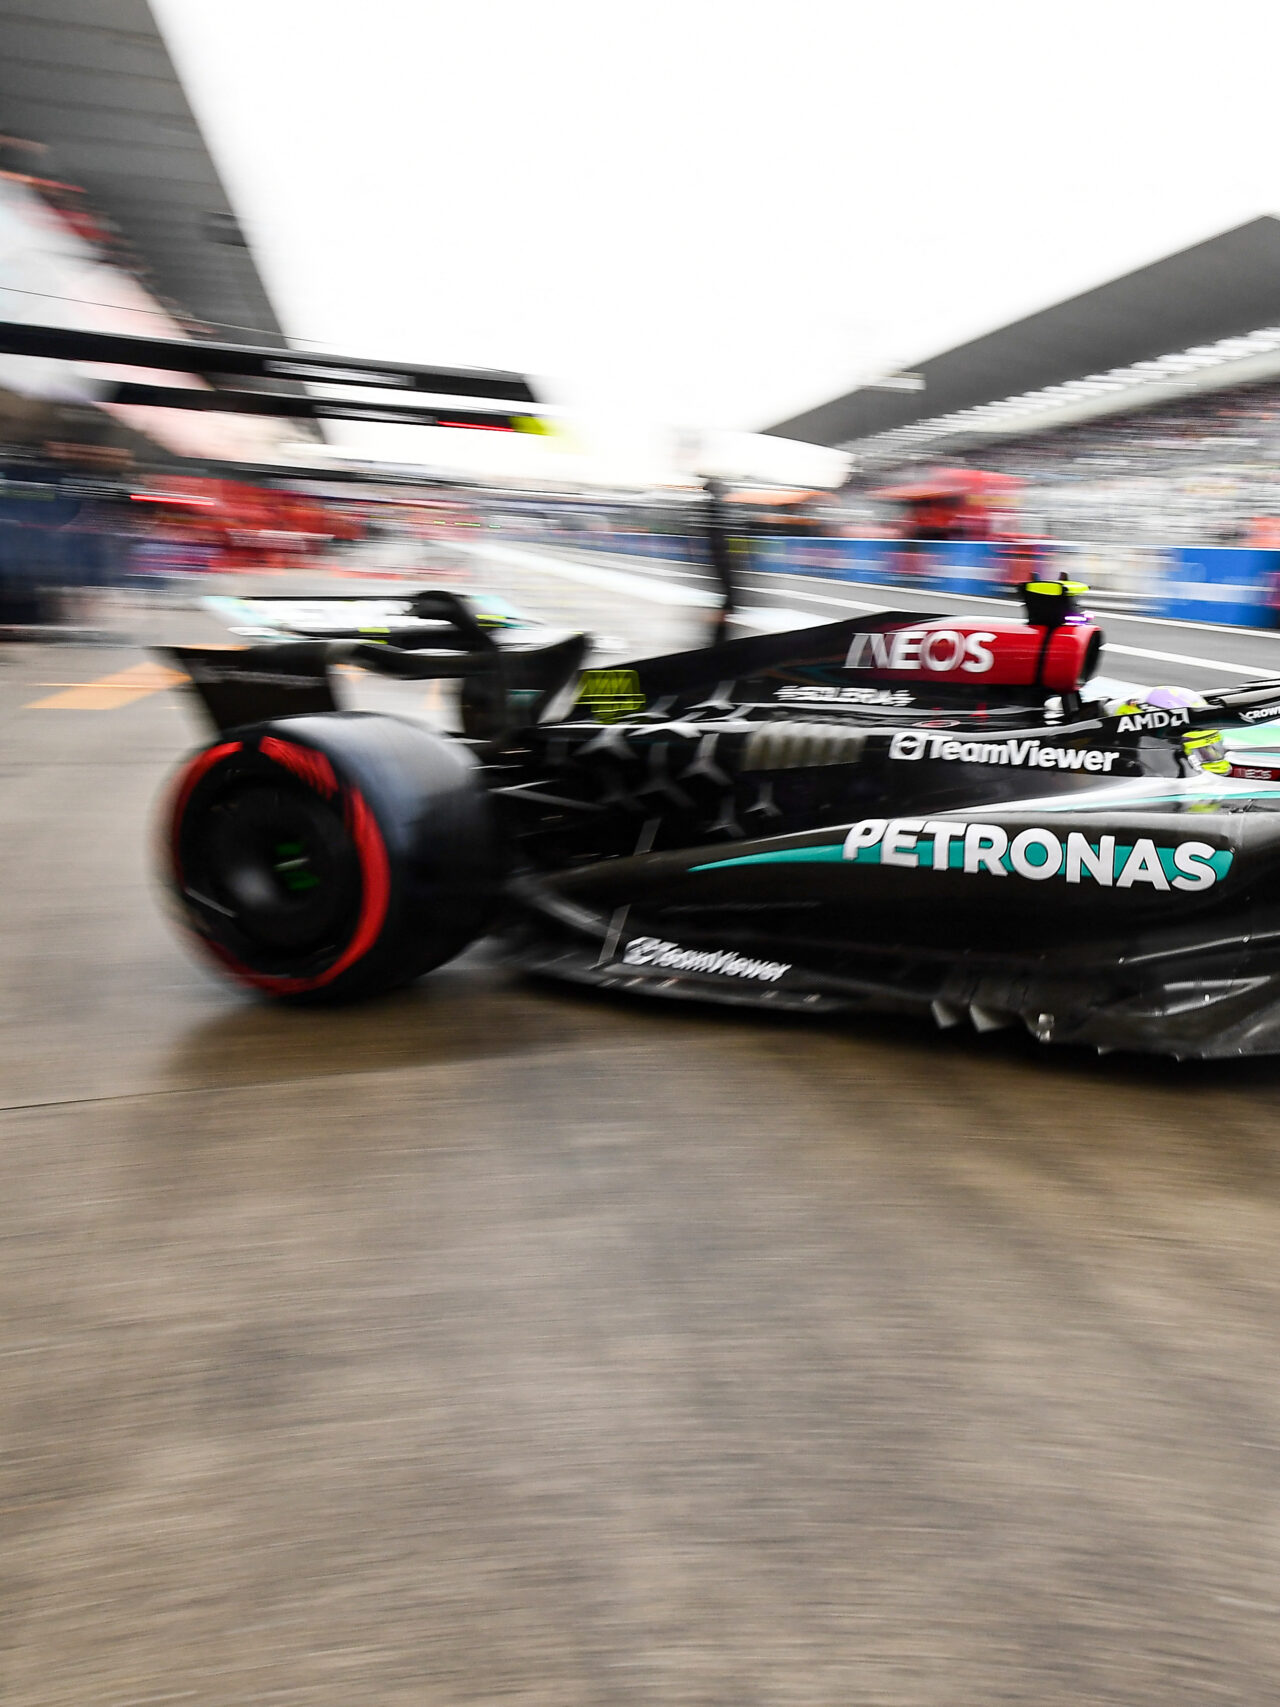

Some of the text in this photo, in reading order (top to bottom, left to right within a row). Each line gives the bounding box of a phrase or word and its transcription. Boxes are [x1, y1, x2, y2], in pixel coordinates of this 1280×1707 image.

[842, 630, 997, 673] INEOS
[1117, 712, 1170, 733] AMD
[926, 734, 1119, 772] TeamViewer
[842, 819, 1217, 892] PETRONAS
